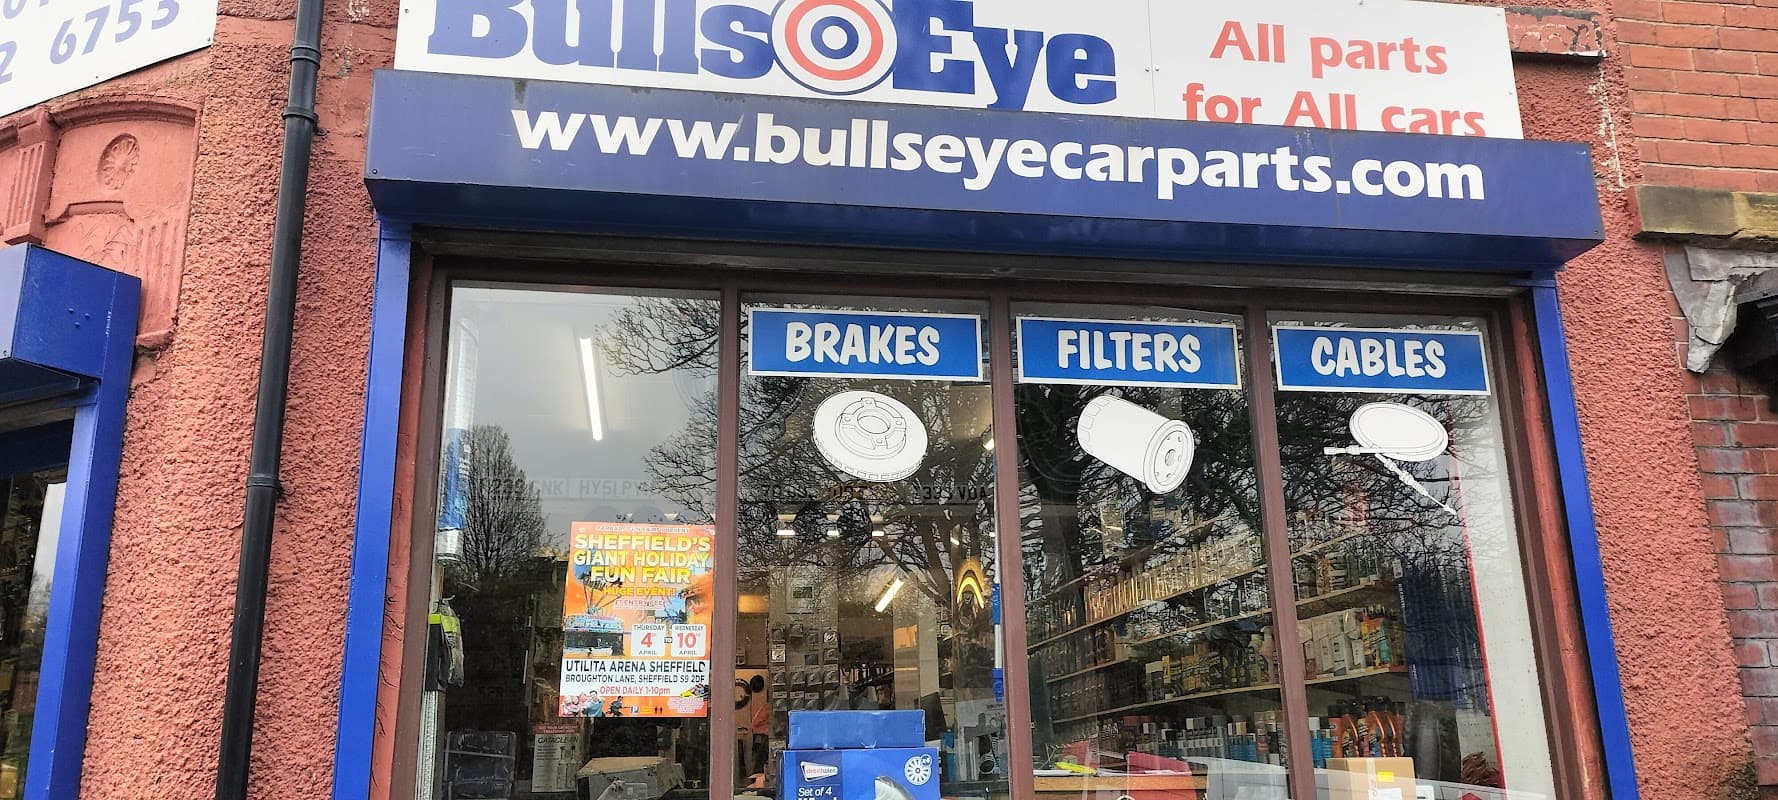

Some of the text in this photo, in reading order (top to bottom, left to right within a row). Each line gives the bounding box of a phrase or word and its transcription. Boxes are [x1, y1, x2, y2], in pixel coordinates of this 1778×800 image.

[427, 0, 1117, 110] Bulls Eye
[1209, 20, 1448, 79] All parts
[1183, 82, 1486, 136] for All cars
[511, 109, 1484, 200] www.bullseyecarparts.com
[785, 321, 941, 366] BRAKES
[1058, 329, 1201, 374] FILTERS
[1311, 336, 1447, 379] CABLES
[574, 533, 711, 552] SHEFFIELD'S
[573, 549, 710, 568] GIANT HOLIDAY
[591, 566, 691, 583] FUN FAIR
[603, 587, 675, 597] HUGE EVENT!
[566, 660, 706, 673] UTILITA ARENA SHEFFIELD
[565, 674, 613, 683] BROUGHTON
[615, 674, 637, 684] LANE,
[638, 674, 678, 683] SHEFFIELD
[680, 675, 689, 683] S9
[600, 686, 671, 696] OPEN DAILY 1-10pm
[798, 786, 833, 797] Set of 4
